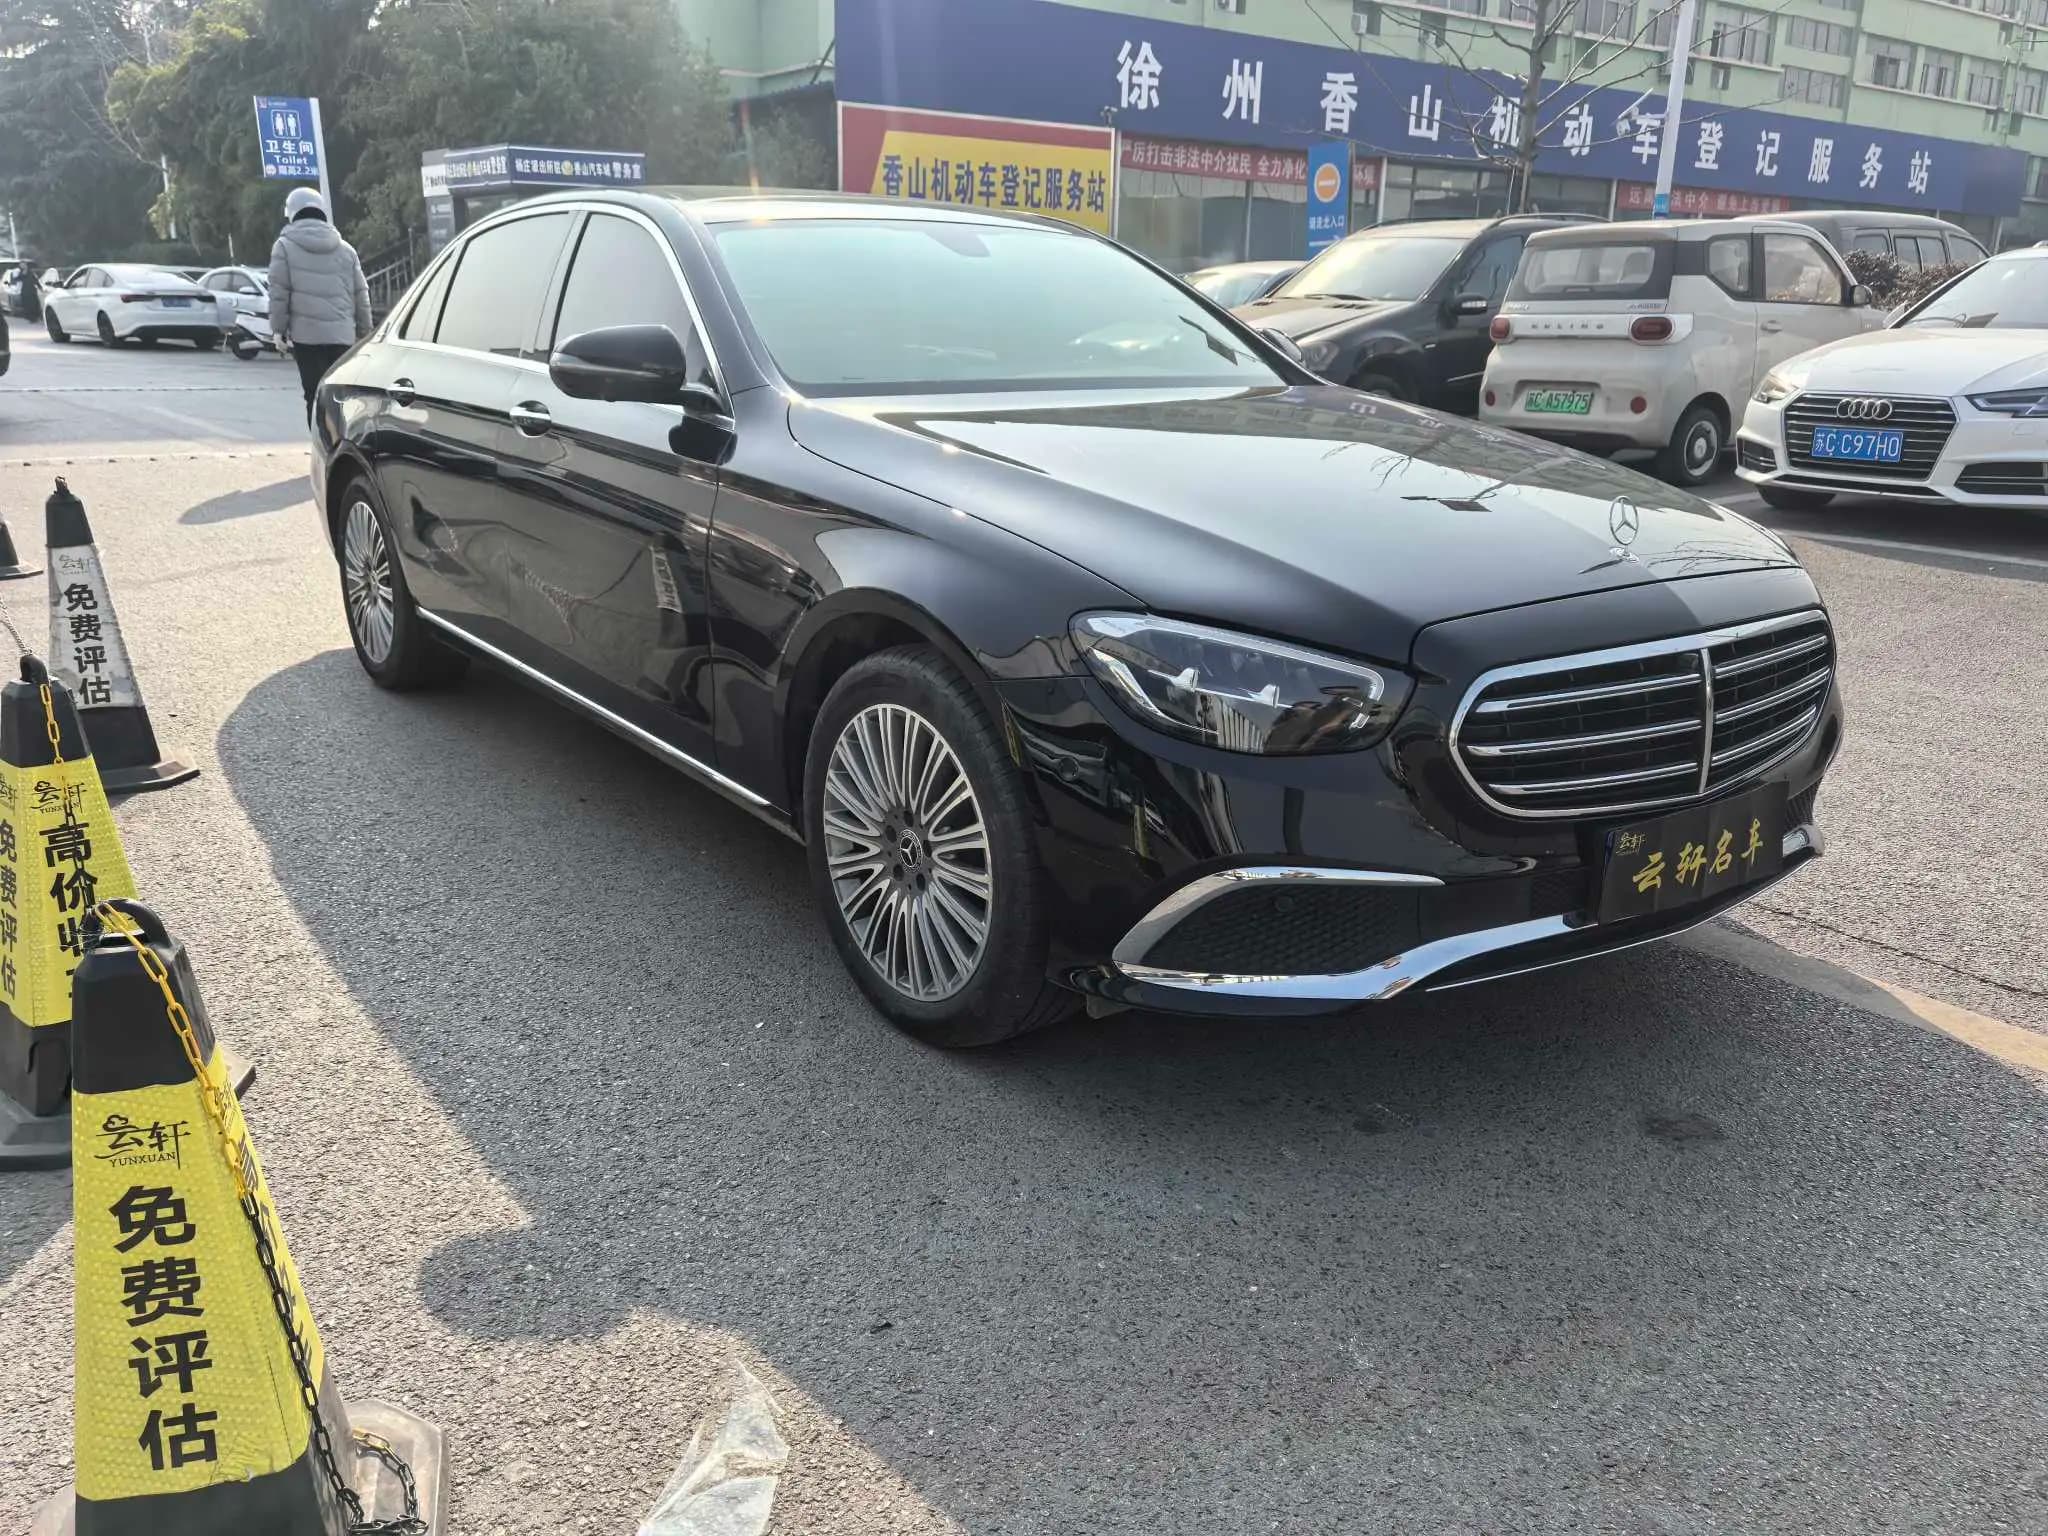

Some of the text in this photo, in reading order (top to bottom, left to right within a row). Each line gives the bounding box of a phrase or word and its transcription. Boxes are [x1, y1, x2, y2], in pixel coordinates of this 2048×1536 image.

[265, 140, 314, 155] 卫生间
[274, 155, 308, 165] Toilet
[882, 154, 1106, 213] 香山机动车登记服务站
[63, 583, 111, 705] 免费评估
[1632, 818, 1763, 893] 云轩名车
[109, 1151, 177, 1168] YUNXUAN
[108, 1185, 219, 1471] 免费评估
